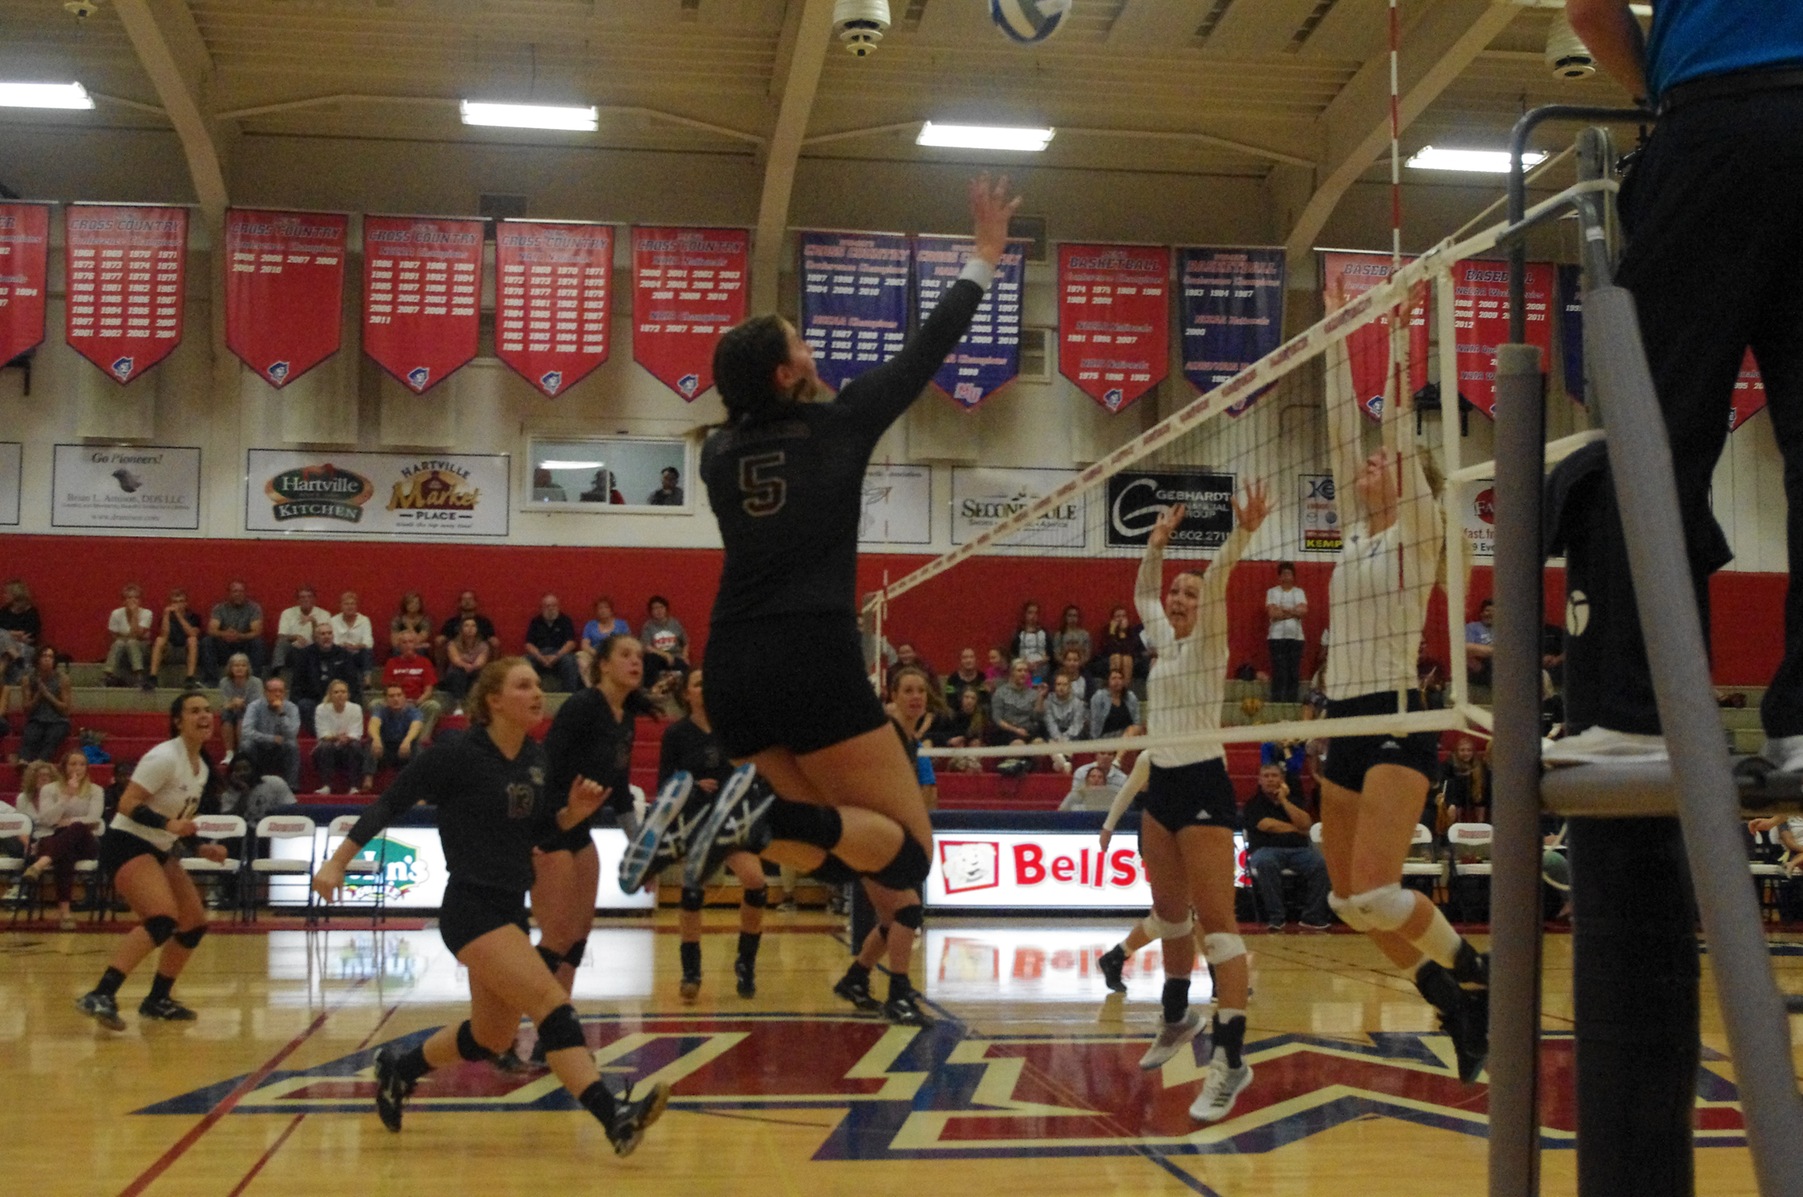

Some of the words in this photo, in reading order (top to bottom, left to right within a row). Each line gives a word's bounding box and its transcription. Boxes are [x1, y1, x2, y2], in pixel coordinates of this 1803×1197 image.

[1070, 257, 1160, 271] BASKETBALL
[1466, 270, 1534, 284] BASEBL
[92, 452, 108, 464] Go
[111, 454, 163, 465] Pioneers!
[401, 460, 471, 479] HARTVILLE
[282, 476, 359, 494] Hartville
[739, 451, 787, 517] 5
[1156, 490, 1231, 502] GEBHARDT
[279, 504, 358, 519] KITCHEN
[416, 511, 456, 521] PLACE
[961, 499, 1028, 519] SECON
